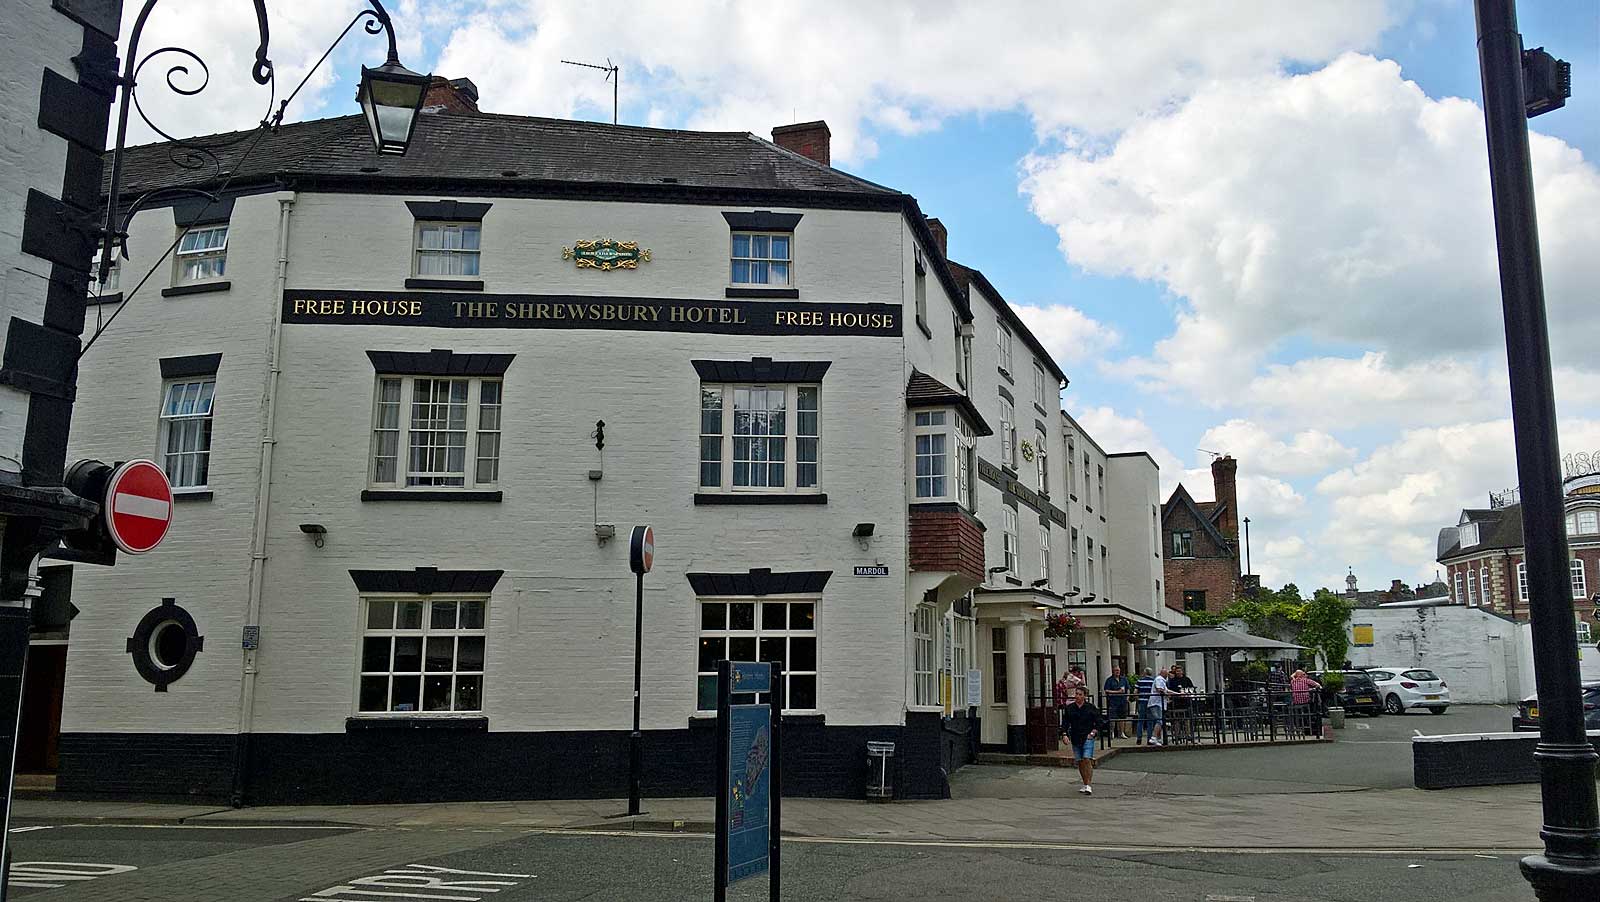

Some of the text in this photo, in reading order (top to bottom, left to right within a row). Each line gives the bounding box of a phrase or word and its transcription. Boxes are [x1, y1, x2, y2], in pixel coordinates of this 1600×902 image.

[293, 299, 423, 316] FREE HOUSE
[452, 301, 747, 324] THE SHREWSBURY HOTEL
[775, 310, 894, 329] FREE HOUSE
[856, 567, 887, 575] MARDOL
